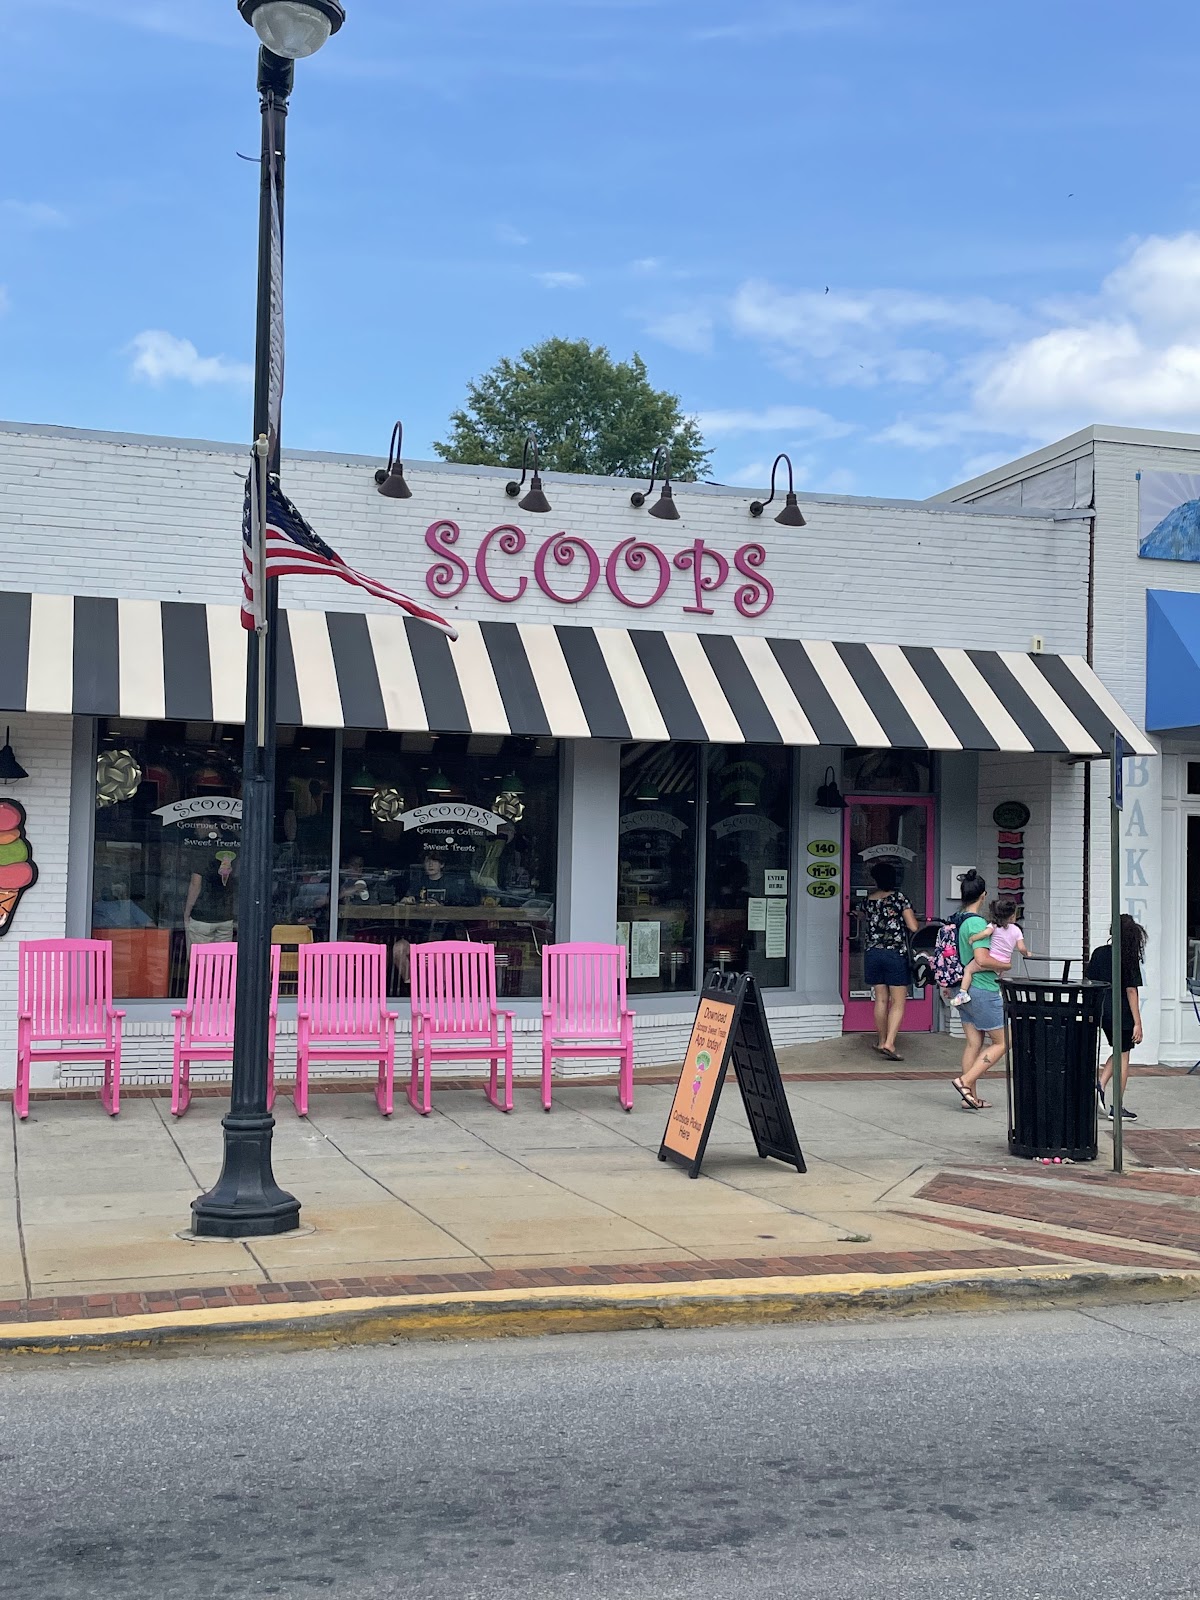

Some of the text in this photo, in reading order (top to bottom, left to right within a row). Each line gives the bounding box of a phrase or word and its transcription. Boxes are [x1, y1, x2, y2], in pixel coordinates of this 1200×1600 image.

[424, 519, 774, 618] SCOOPS
[172, 799, 242, 818] SCOOP
[413, 805, 492, 826] SCOOPS
[176, 821, 218, 830] Gourmet
[416, 826, 484, 836] Gourmet Coffee
[184, 838, 212, 847] Sweet
[423, 843, 476, 852] Sweet Treats
[815, 843, 835, 853] 140
[812, 867, 837, 877] 11-10
[704, 1007, 727, 1023] Download
[672, 1109, 690, 1126] Curbside
[678, 1126, 690, 1140] Here
